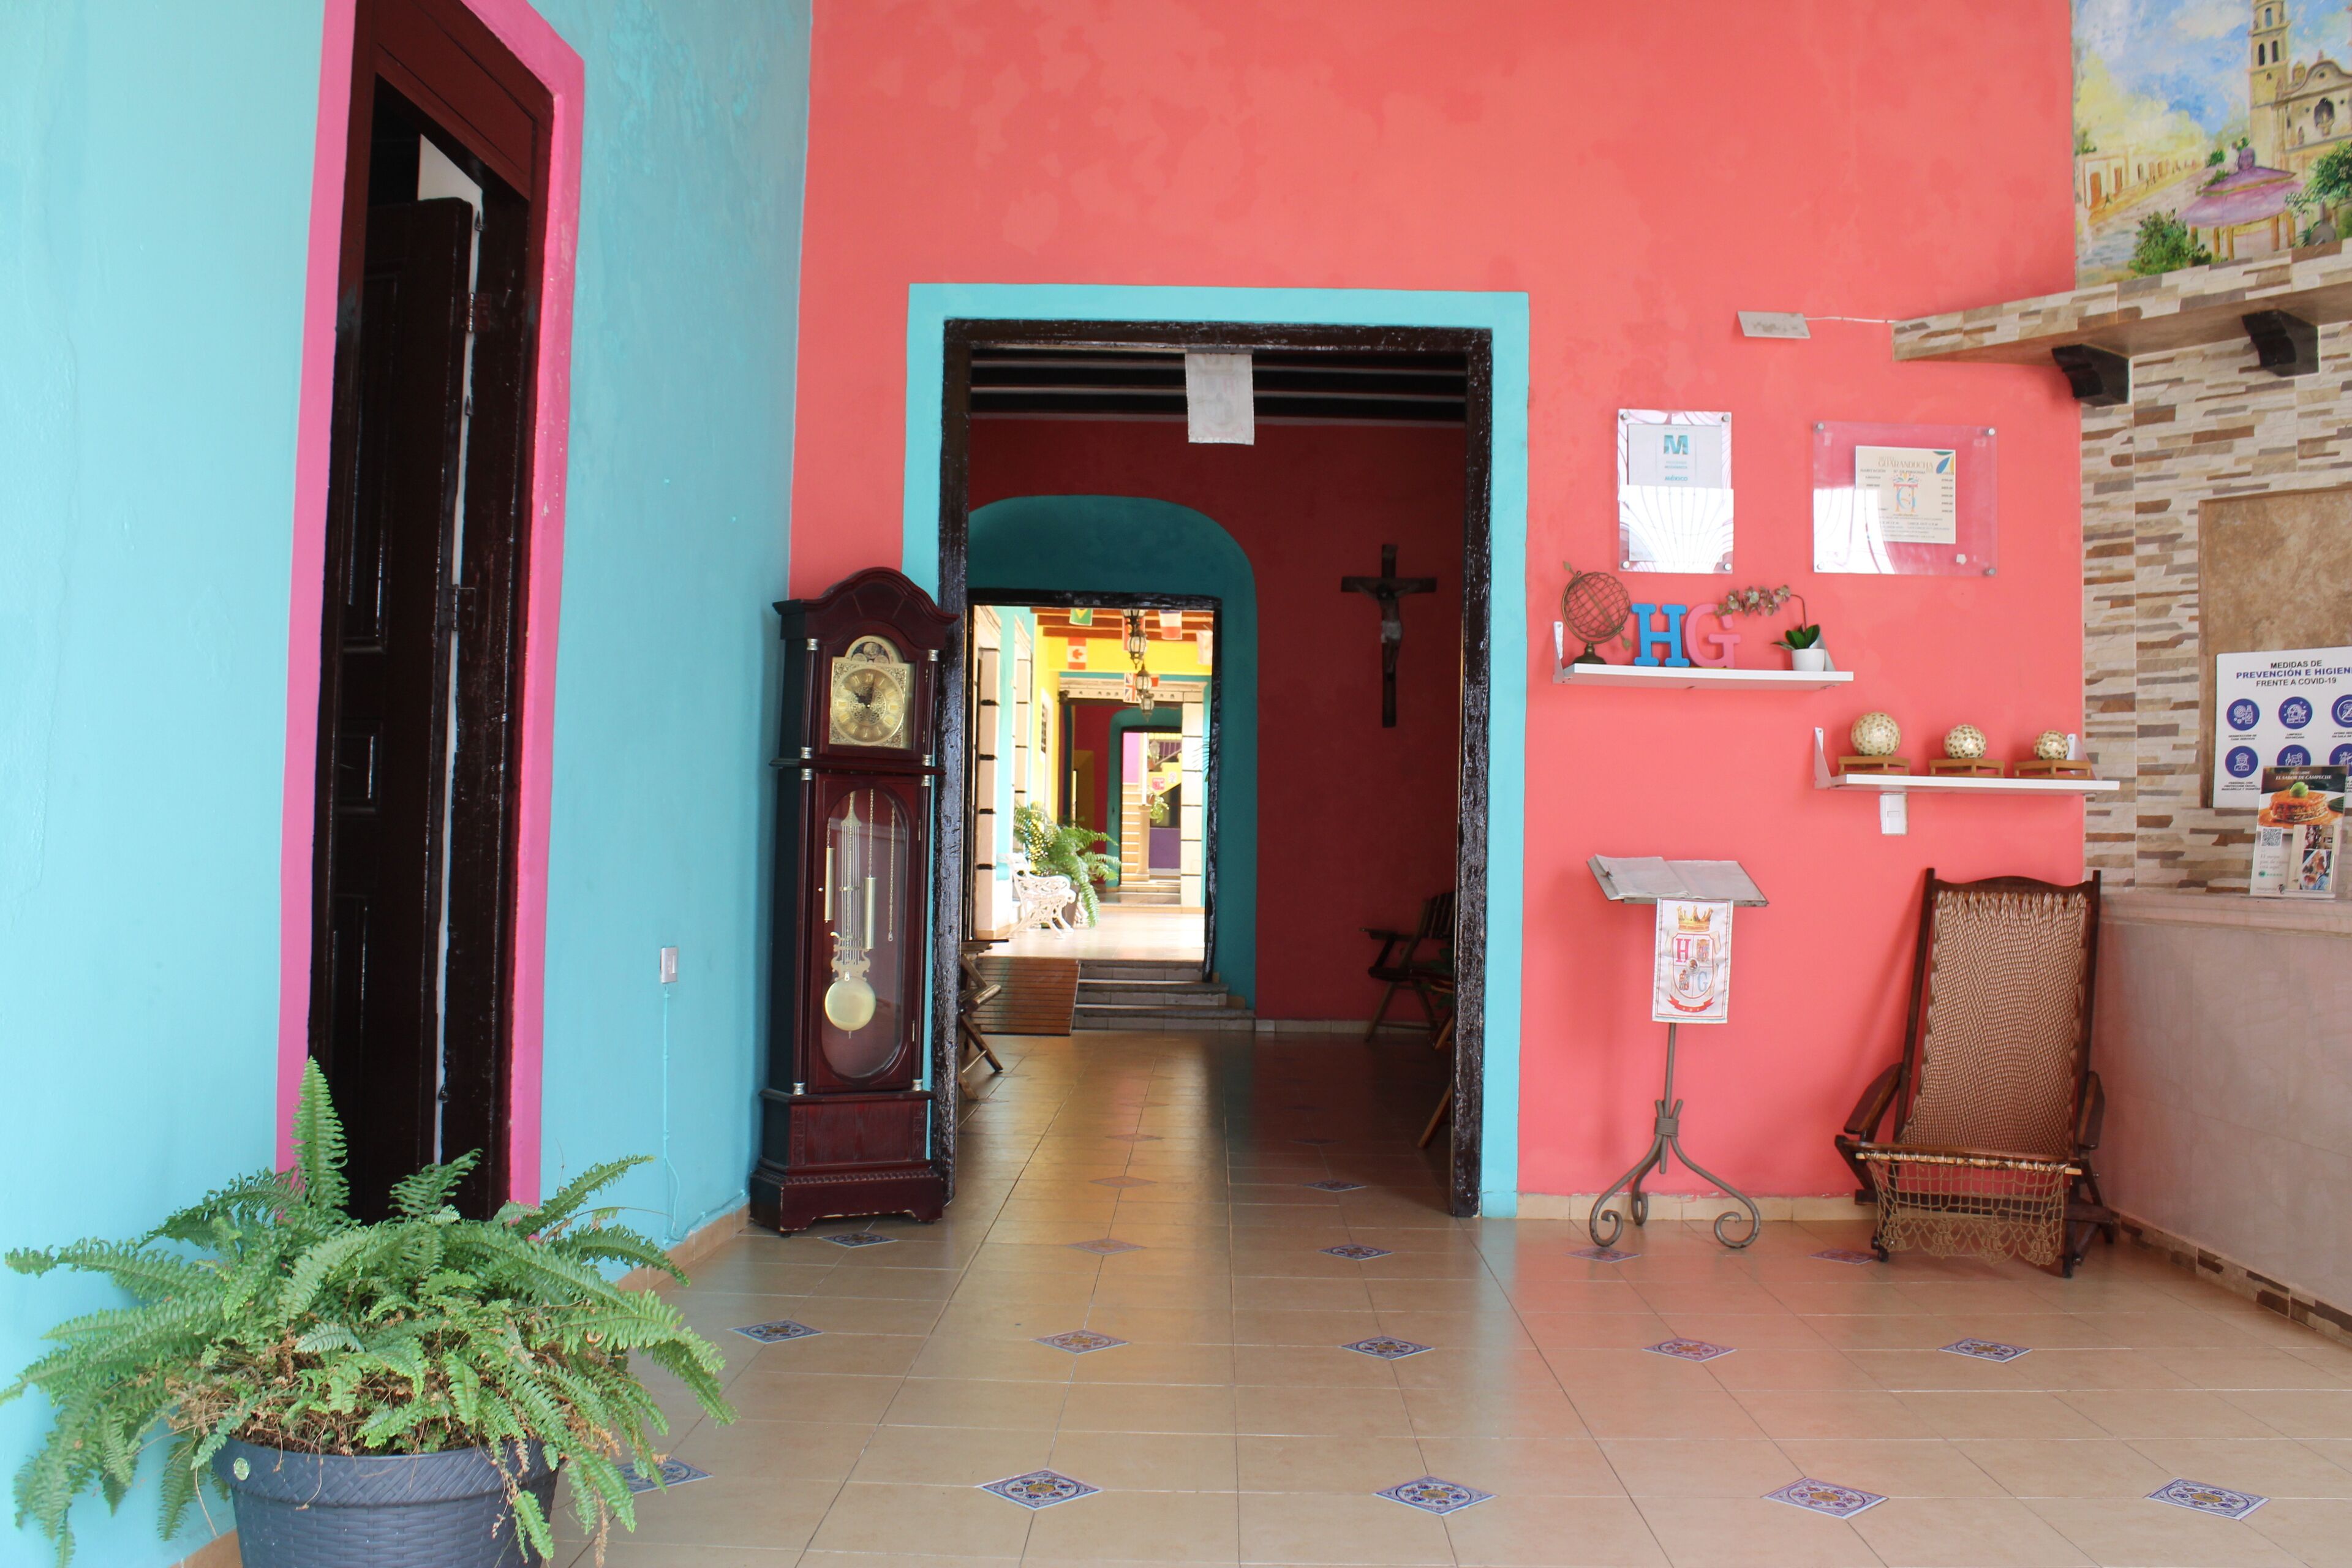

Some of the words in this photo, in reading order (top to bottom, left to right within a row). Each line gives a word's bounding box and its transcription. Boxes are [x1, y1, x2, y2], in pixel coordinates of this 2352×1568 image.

[1664, 434, 1689, 454] M
[1878, 460, 1934, 469] GUARANDUCHA
[2236, 668, 2302, 679] PREVENCIÓN
[2314, 666, 2352, 675] HIGIEN
[2298, 676, 2337, 685] COVID-19
[1675, 938, 1691, 962] H
[1697, 971, 1708, 992] G
